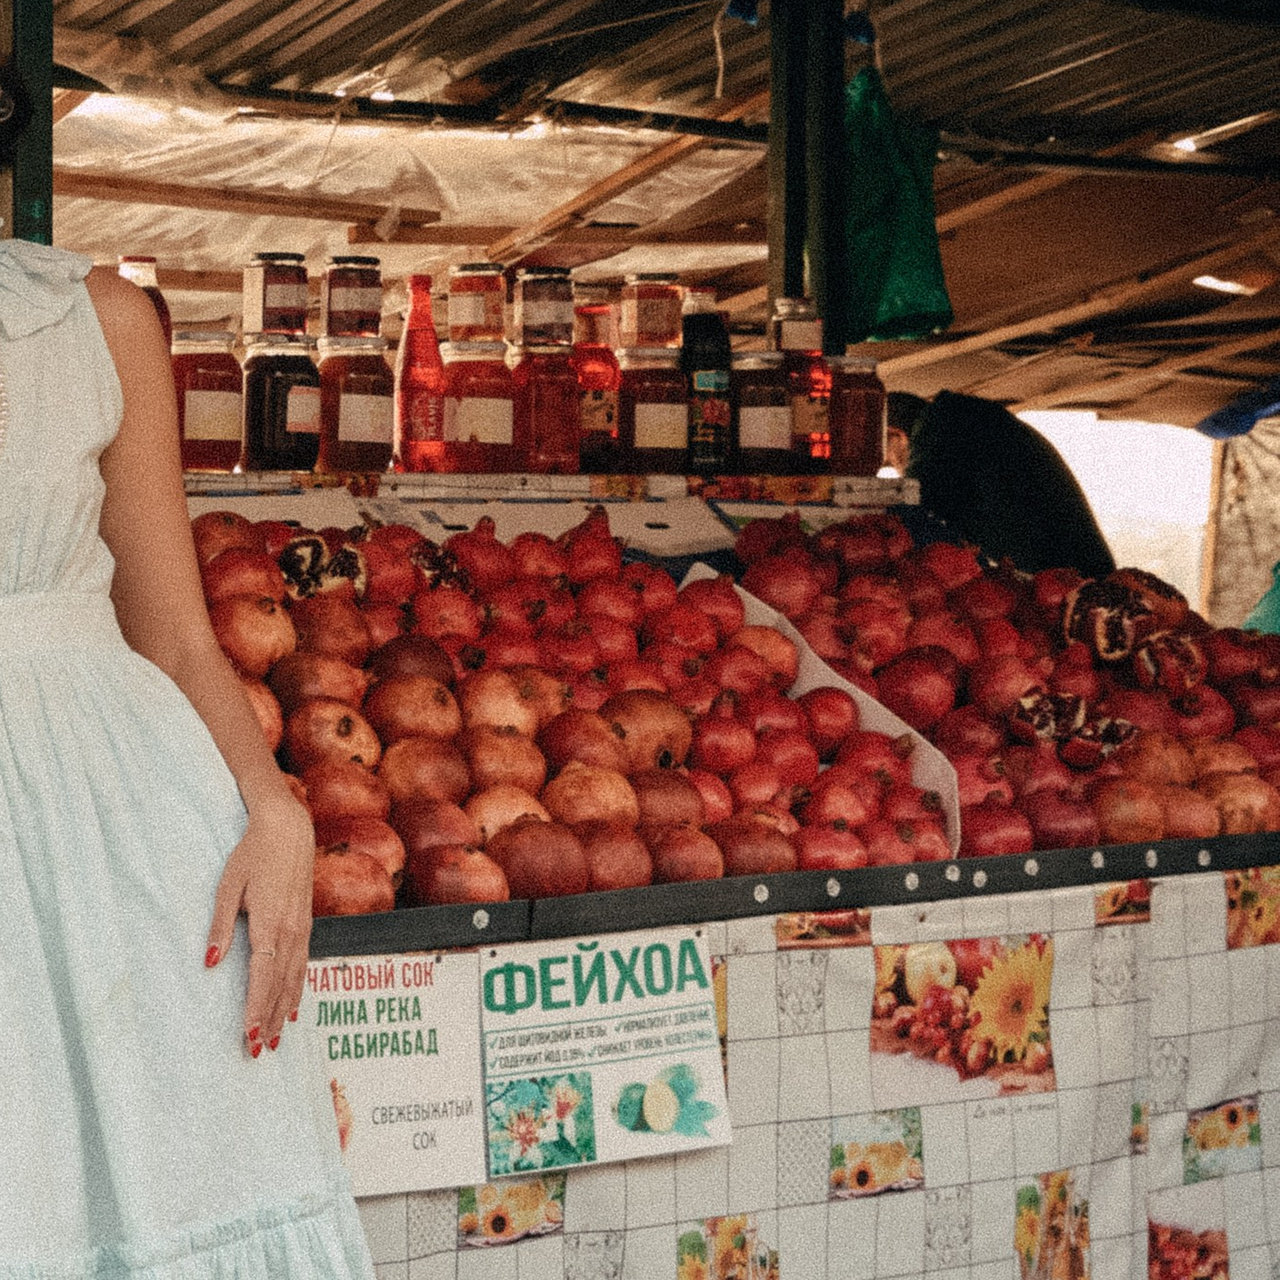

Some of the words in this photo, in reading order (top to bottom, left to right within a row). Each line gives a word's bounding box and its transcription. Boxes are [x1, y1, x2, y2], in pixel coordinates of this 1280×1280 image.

[401, 960, 434, 988] СОК
[483, 938, 709, 1016] ФЕЙХОА
[316, 998, 368, 1027] ЛИНА
[376, 995, 422, 1023] РЕКА
[328, 1027, 440, 1061] САБИРАБАД
[413, 1130, 437, 1151] СОК
